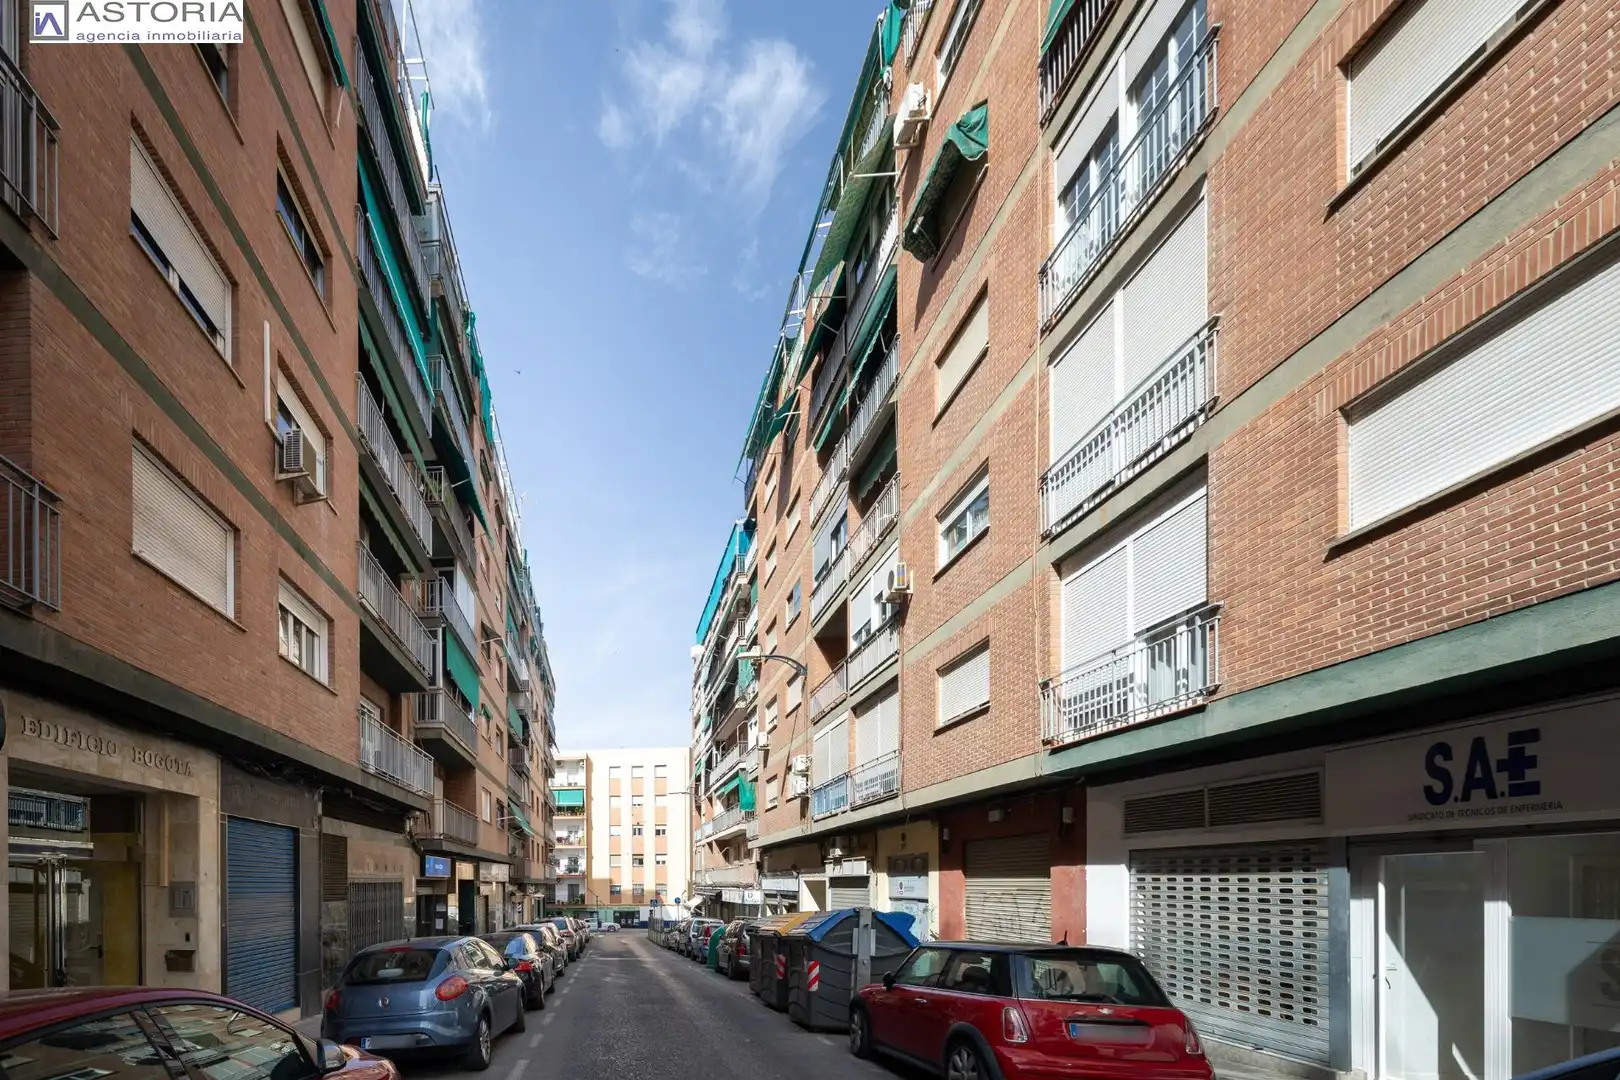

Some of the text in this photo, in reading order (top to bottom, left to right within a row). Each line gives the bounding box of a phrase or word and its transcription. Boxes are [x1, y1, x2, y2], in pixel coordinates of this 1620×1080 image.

[22, 716, 194, 777] EDIFICIO BOGOTA
[1407, 810, 1444, 822] SINDICATO
[1445, 810, 1456, 819] DE
[1497, 805, 1508, 815] DE
